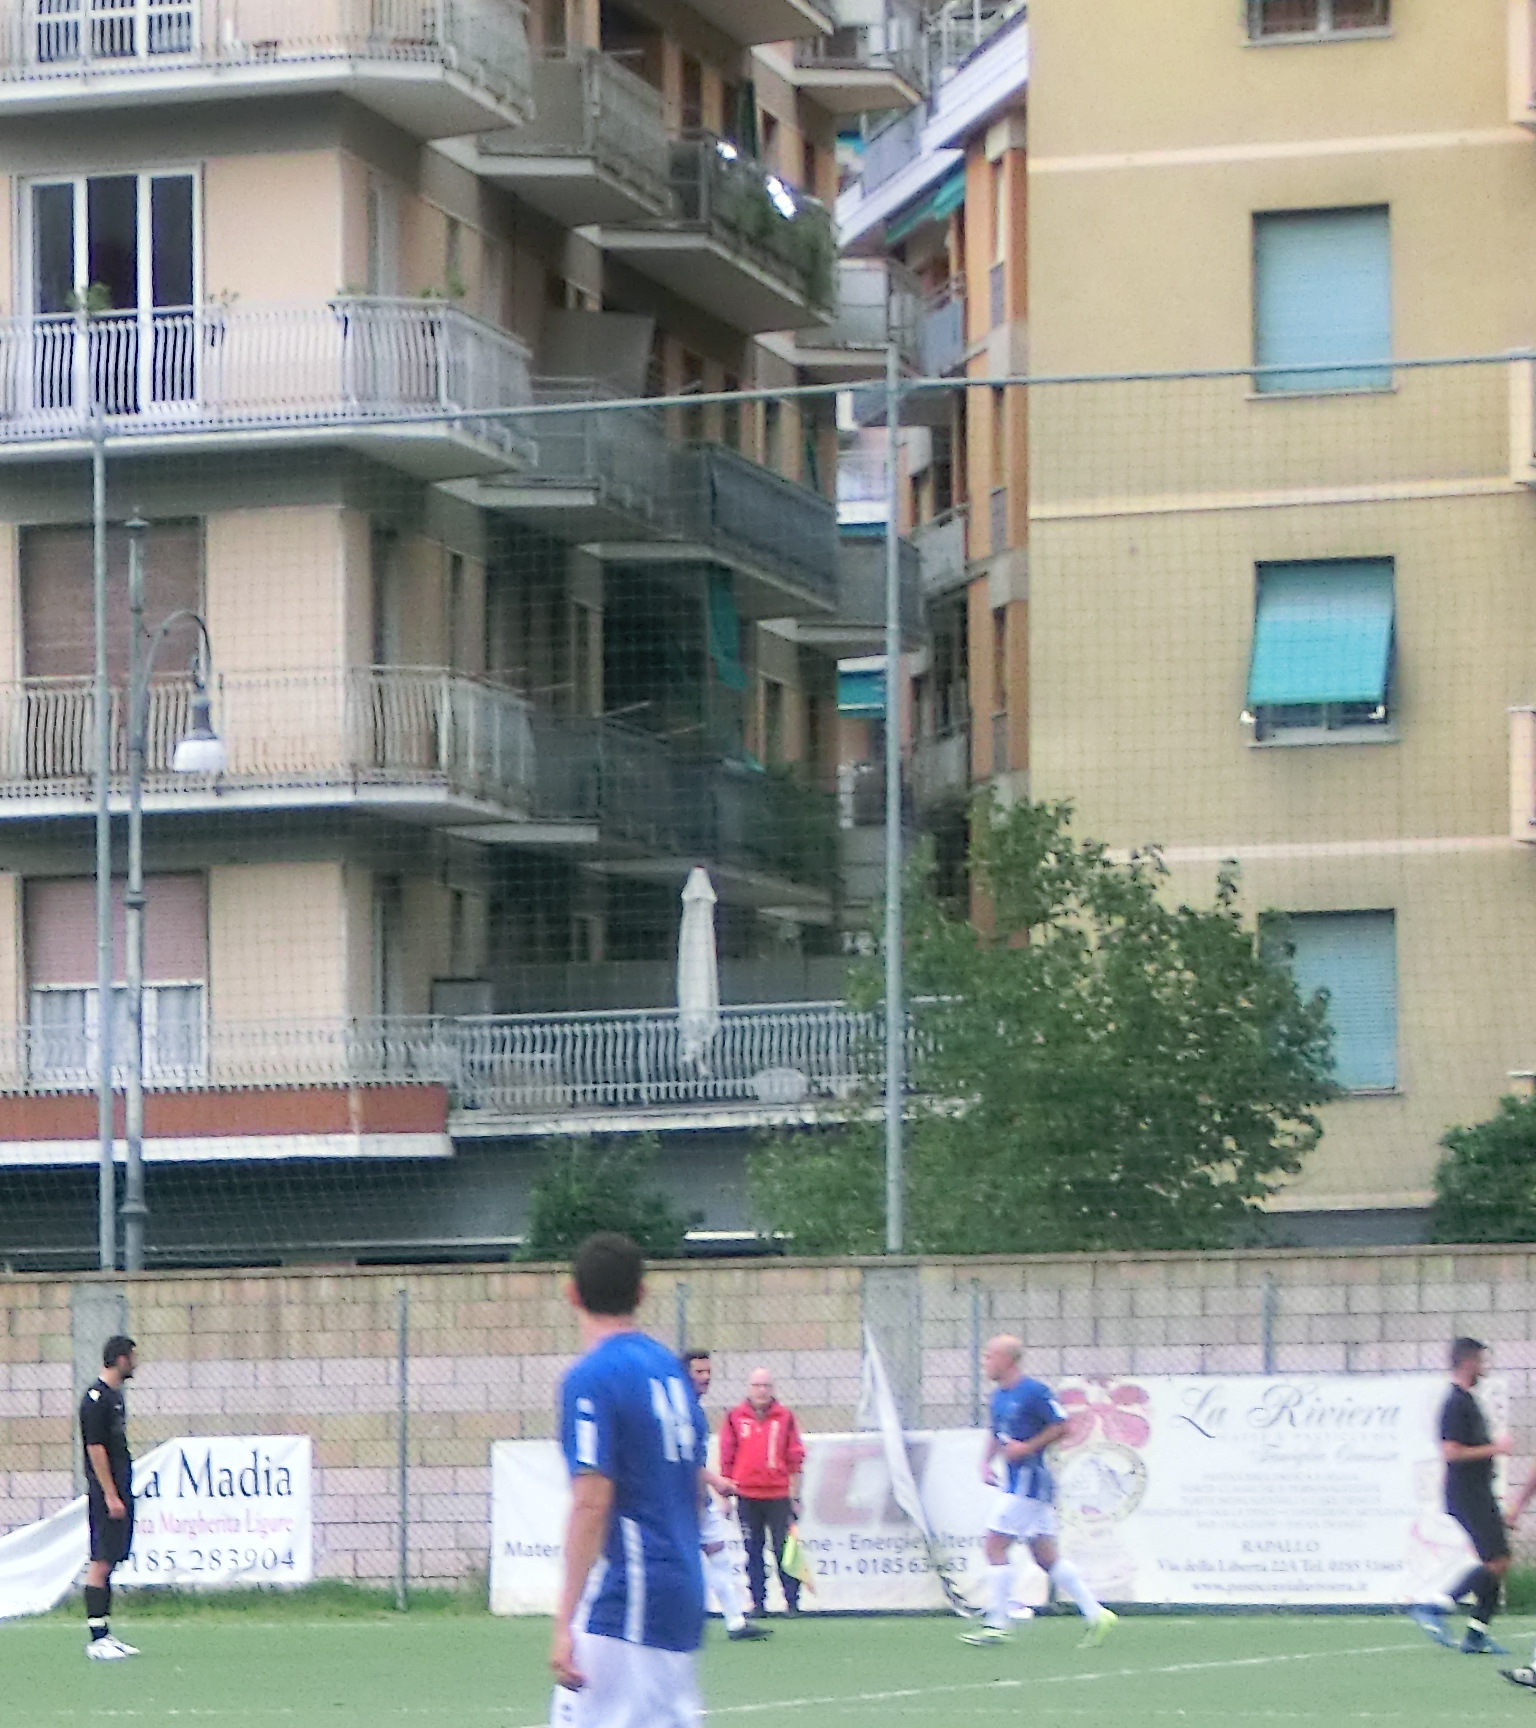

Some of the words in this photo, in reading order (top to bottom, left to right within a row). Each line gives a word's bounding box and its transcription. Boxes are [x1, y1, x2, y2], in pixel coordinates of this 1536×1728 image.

[1247, 1383, 1402, 1428] Riviera
[178, 1447, 293, 1498] Madia
[246, 1509, 294, 1539] Ligure
[190, 1548, 296, 1572] 283904
[1241, 1539, 1320, 1552] RAPALLO
